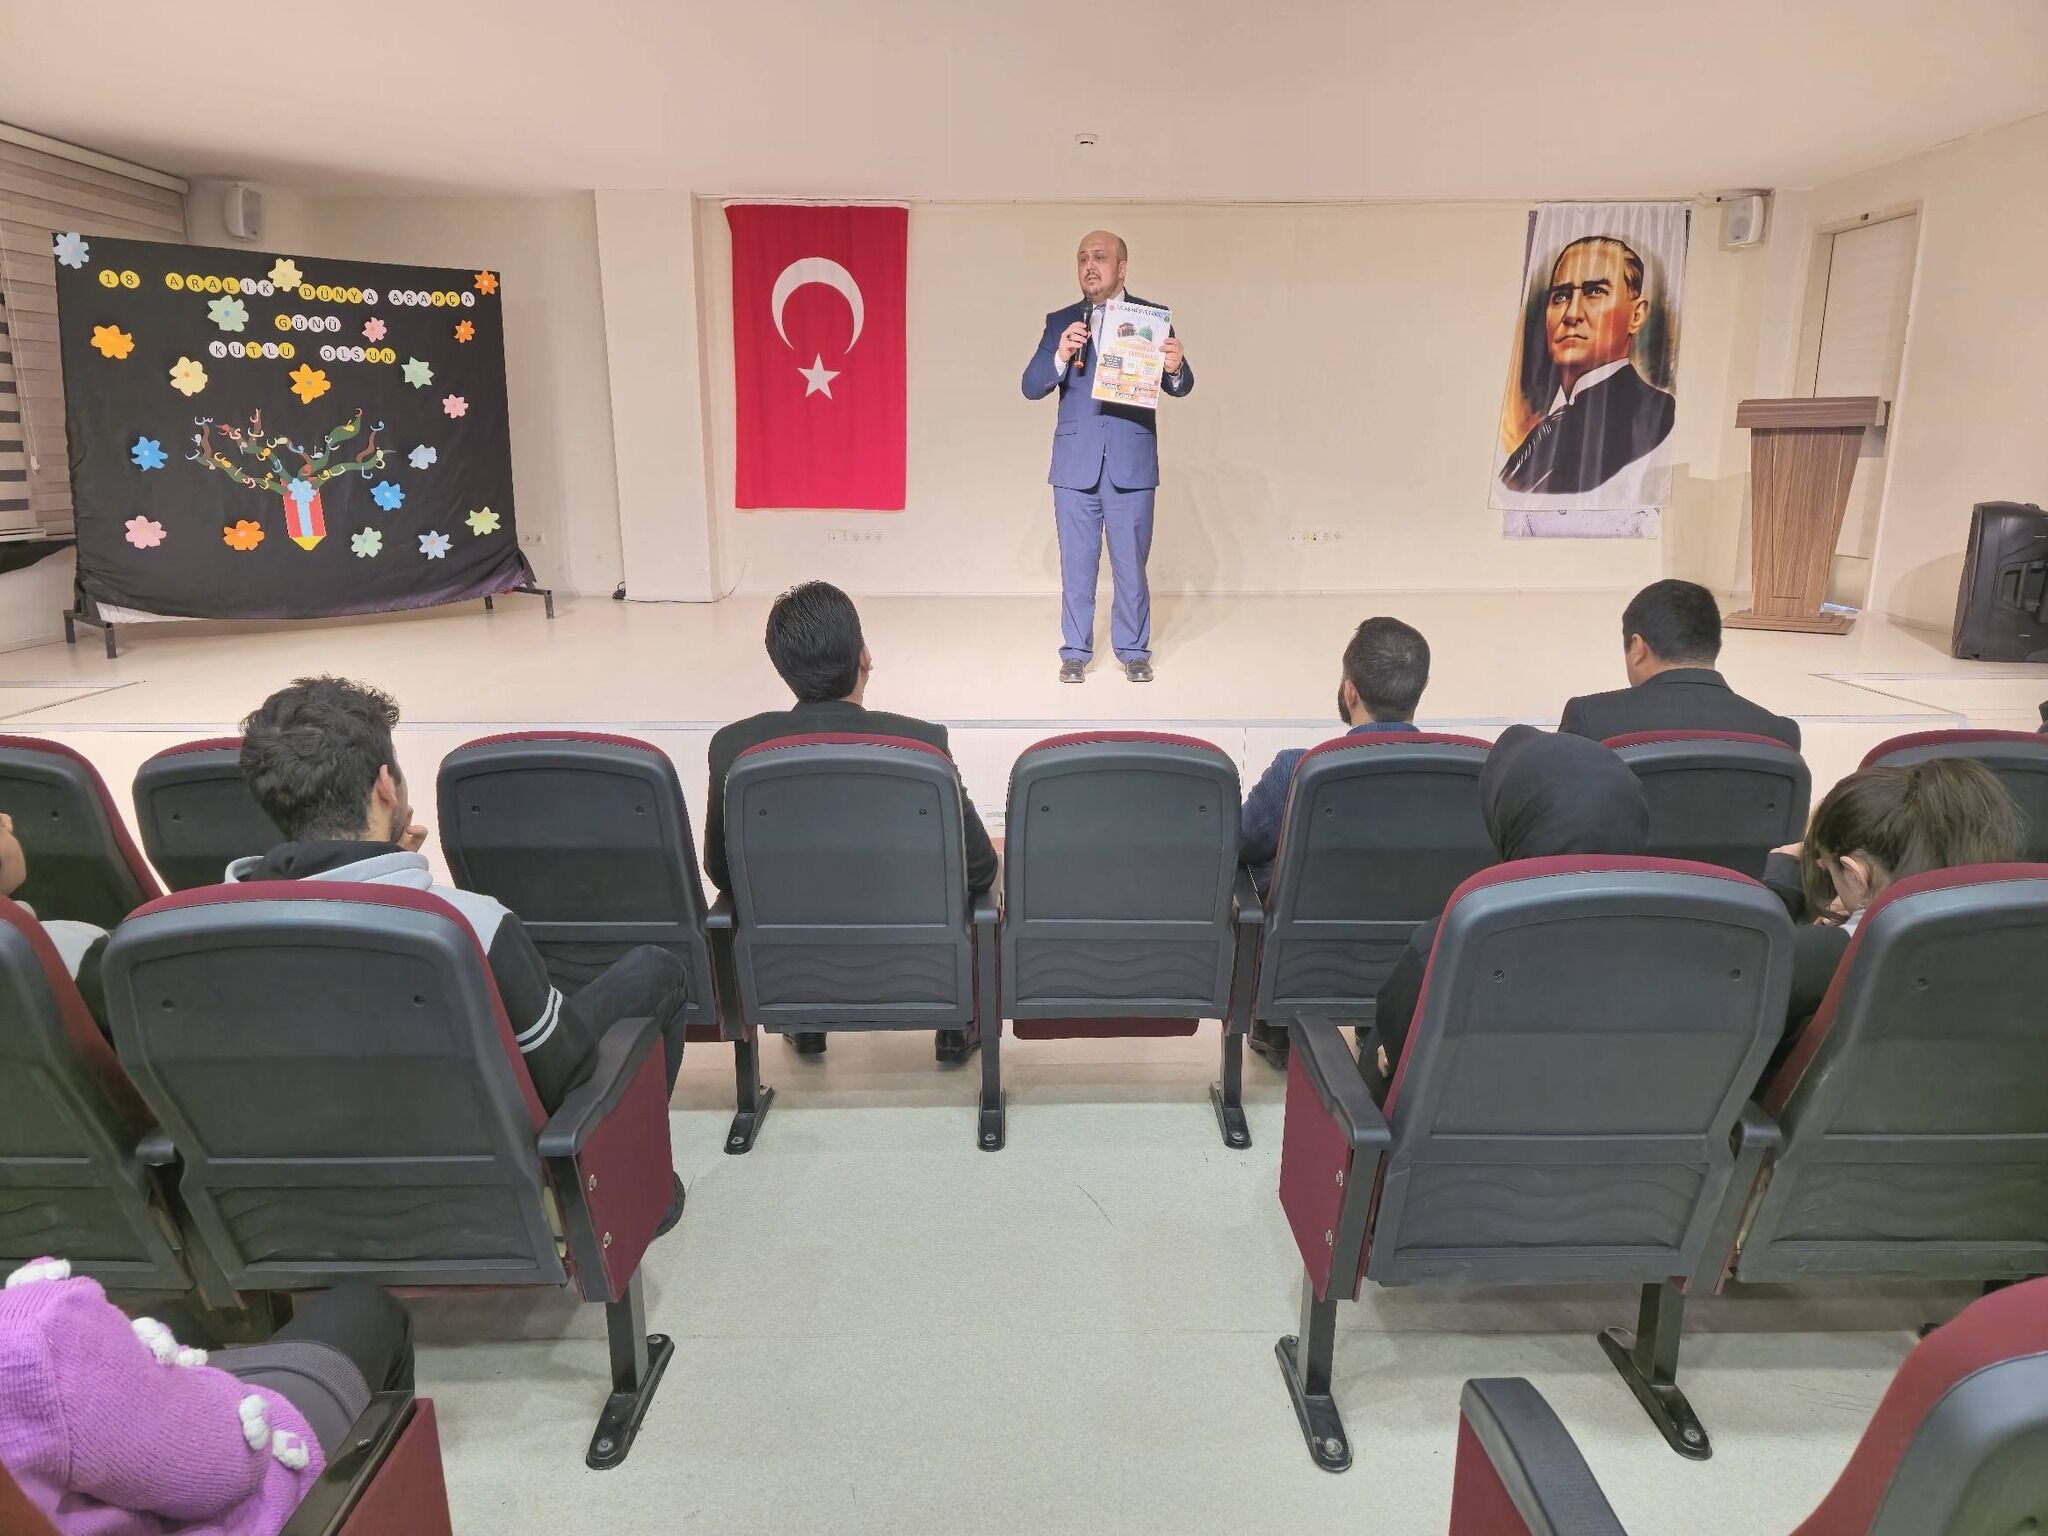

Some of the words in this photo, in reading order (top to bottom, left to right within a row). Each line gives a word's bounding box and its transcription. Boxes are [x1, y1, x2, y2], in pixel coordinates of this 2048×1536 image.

[104, 273, 135, 286] 18
[169, 275, 272, 295] ARALIK
[302, 287, 376, 303] DÜNYA
[391, 291, 473, 305] ARAPÇA
[277, 317, 338, 331] GÜNÜ
[214, 344, 291, 357] KUTLU
[322, 348, 394, 363] OLSUN
